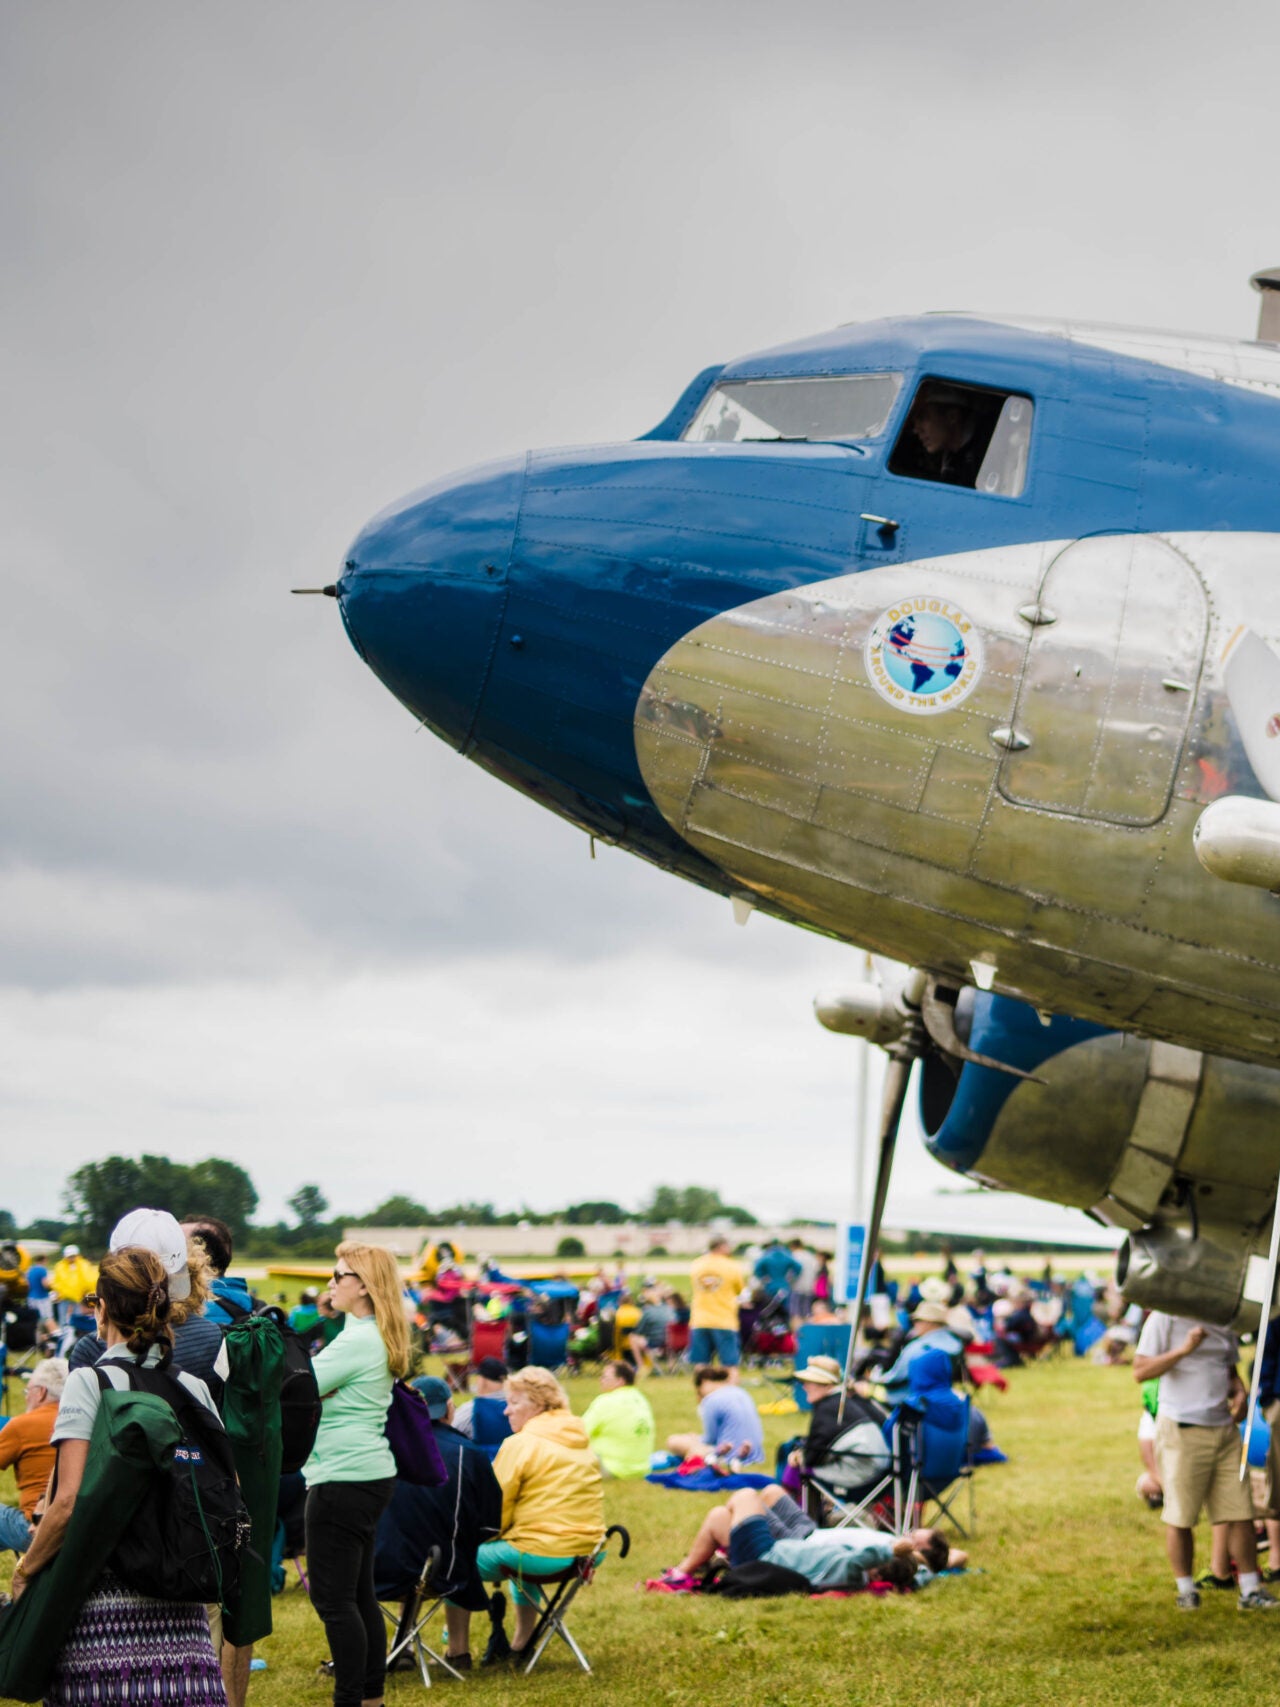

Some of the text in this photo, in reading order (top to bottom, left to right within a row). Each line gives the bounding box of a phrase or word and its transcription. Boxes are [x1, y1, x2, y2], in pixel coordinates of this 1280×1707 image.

[888, 599, 972, 633] DOUGLAS
[870, 646, 977, 708] AROUND THE WORLD
